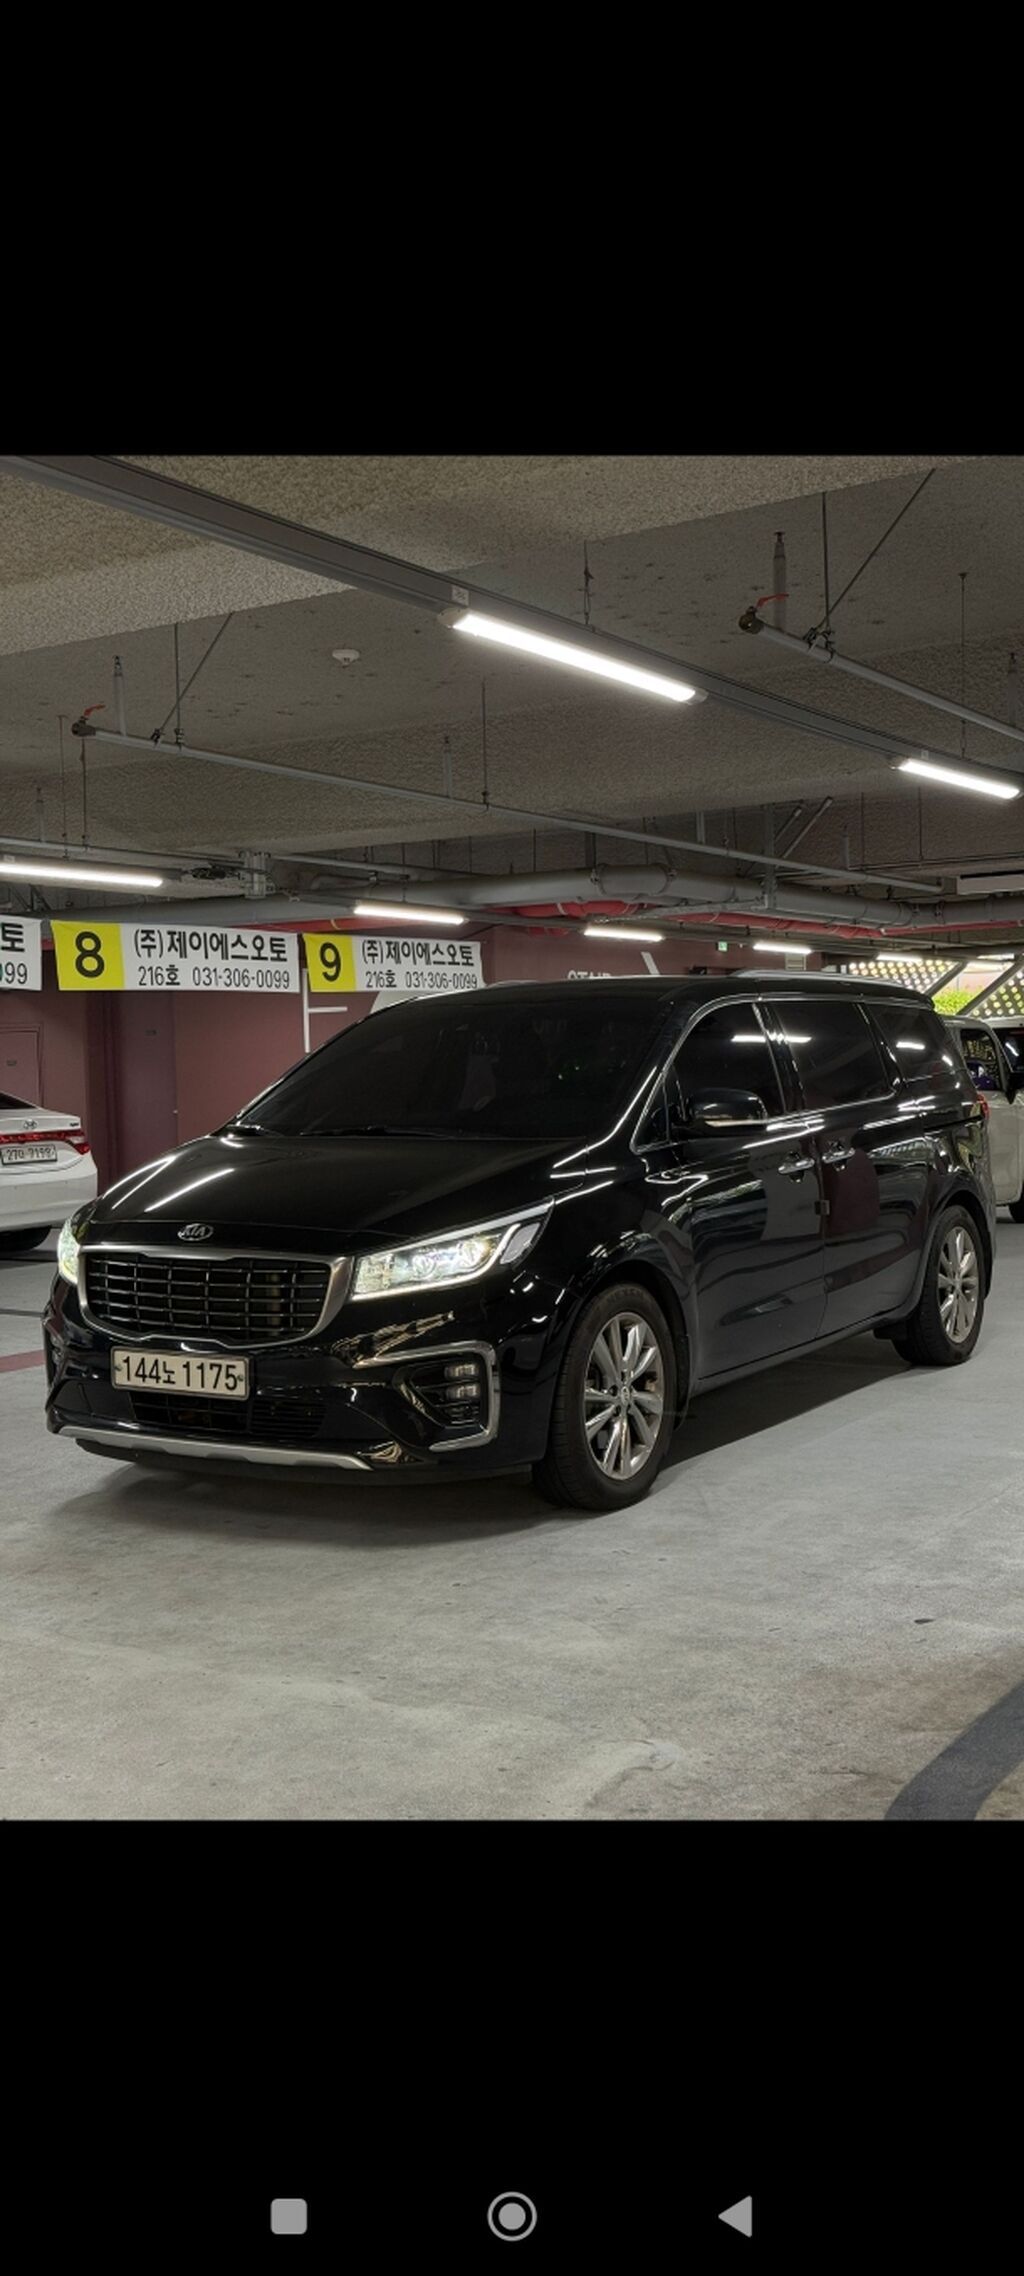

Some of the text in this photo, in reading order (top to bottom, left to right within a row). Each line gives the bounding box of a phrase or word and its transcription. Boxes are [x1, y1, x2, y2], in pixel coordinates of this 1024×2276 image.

[75, 931, 105, 978] 8
[134, 929, 288, 962] (주)제이에스오토
[362, 940, 475, 966] (주)제이에스오토
[0, 961, 28, 985] 99
[319, 942, 341, 982] 9
[138, 964, 290, 989] 216호 031-306-0099
[366, 969, 478, 989] 216호 031-306-0099
[180, 1225, 208, 1238] KIA
[123, 1355, 238, 1391] 144노 1175
